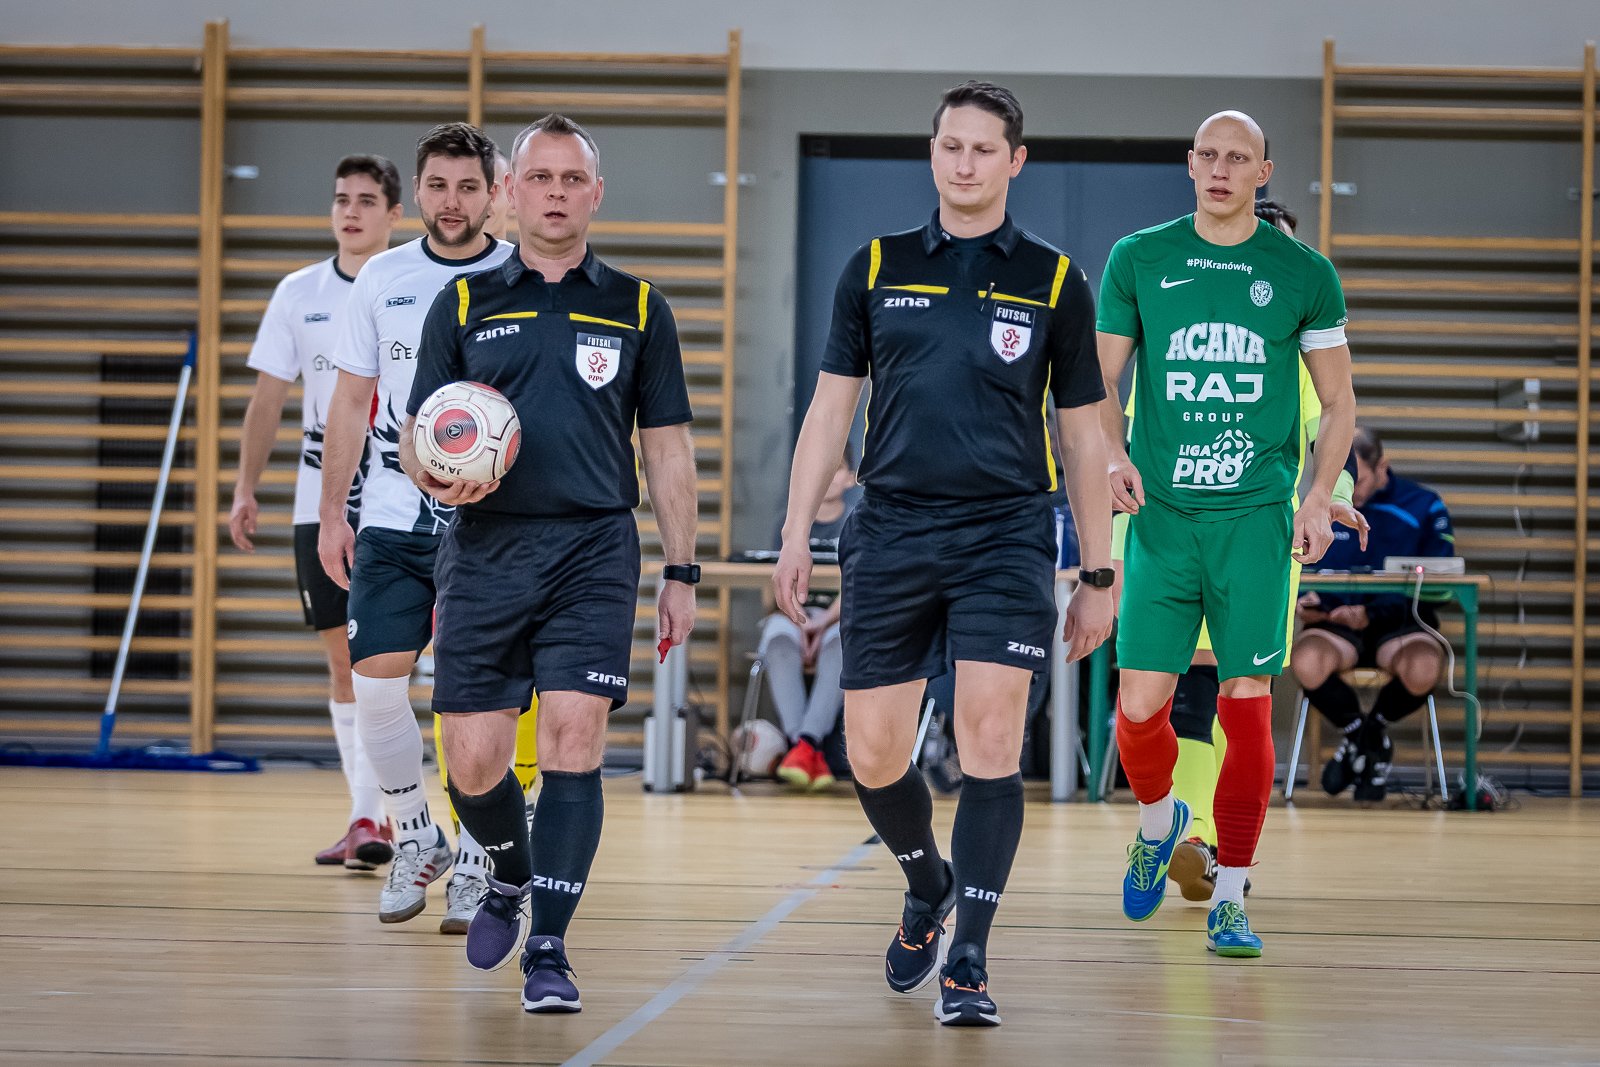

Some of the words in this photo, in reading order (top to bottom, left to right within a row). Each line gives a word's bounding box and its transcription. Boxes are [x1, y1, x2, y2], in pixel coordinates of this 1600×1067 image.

[1186, 258, 1253, 275] #PijKranówkę
[884, 297, 930, 308] zina
[996, 307, 1032, 323] FUTSAL
[475, 324, 520, 342] zina
[587, 336, 612, 348] FUTSAL
[1165, 322, 1267, 364] ACANA
[588, 374, 605, 383] PZPN
[1166, 371, 1264, 403] RAJ
[1183, 412, 1244, 423] GROUP
[1178, 444, 1212, 457] LIGA
[1172, 457, 1244, 484] PRO
[1007, 641, 1046, 658] zina
[586, 671, 627, 687] zina
[532, 874, 583, 894] zina
